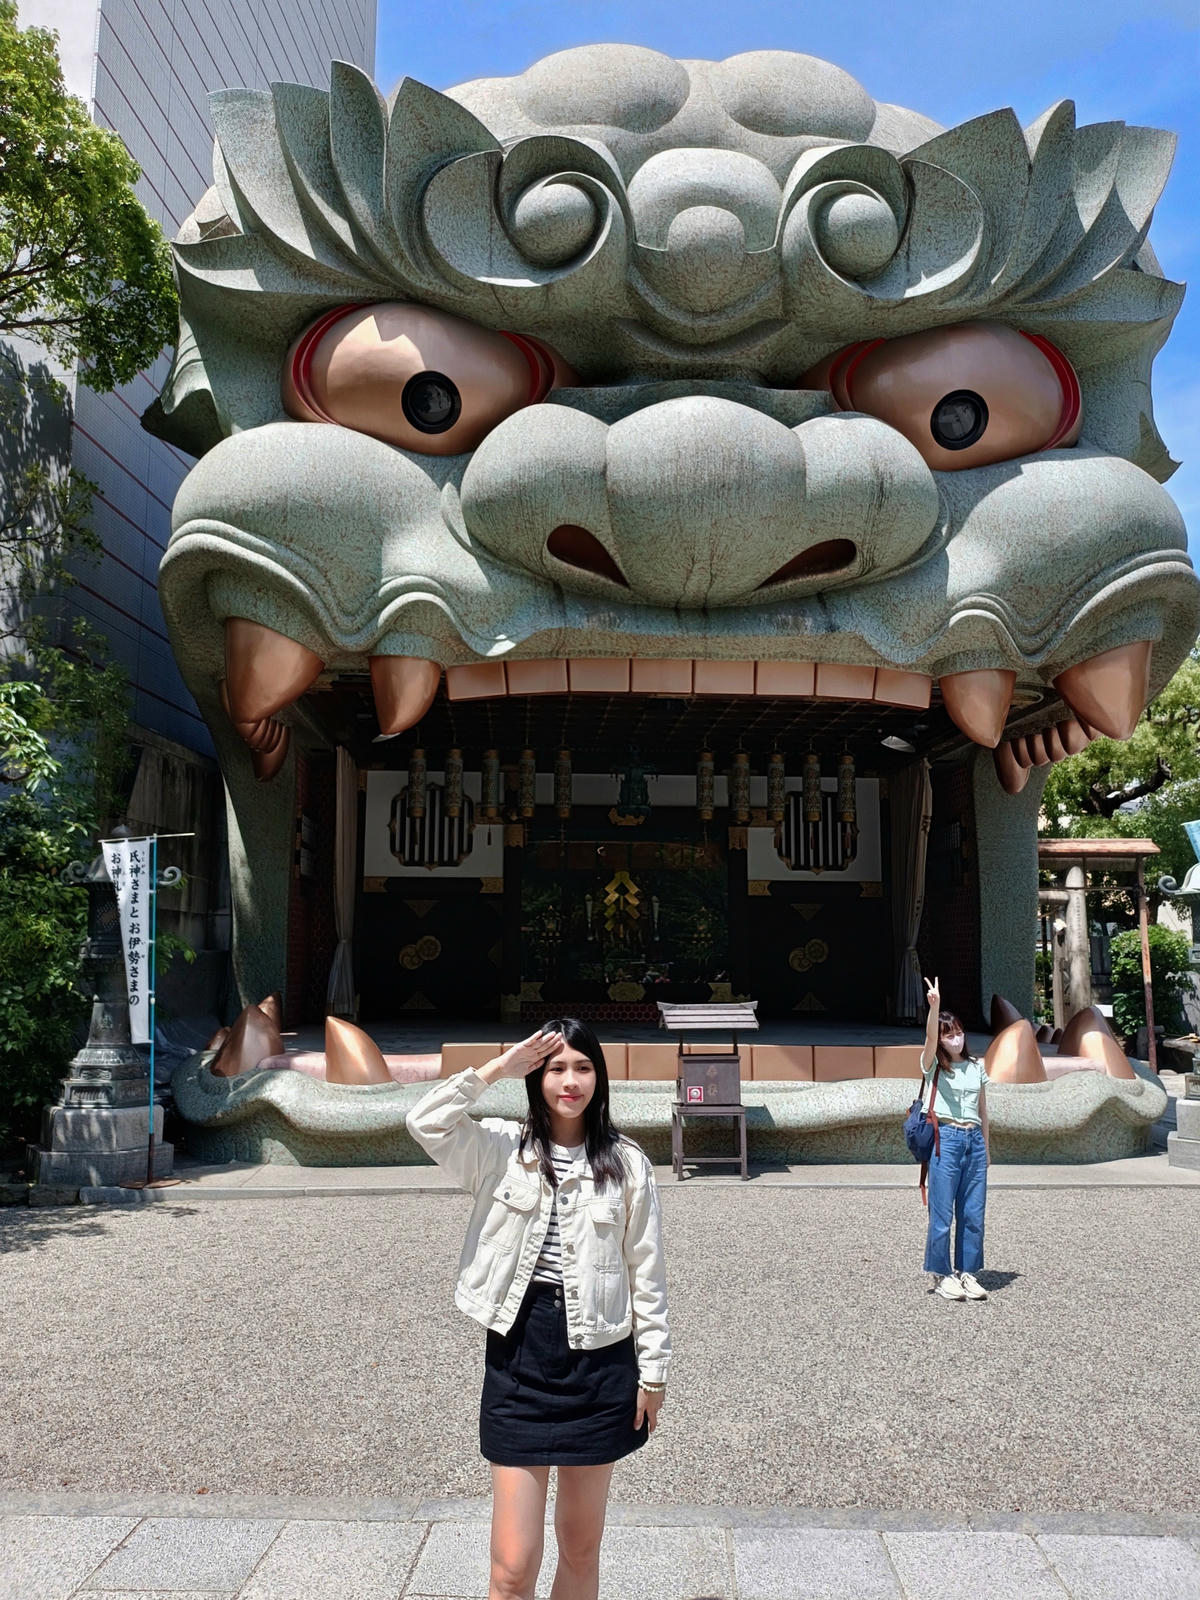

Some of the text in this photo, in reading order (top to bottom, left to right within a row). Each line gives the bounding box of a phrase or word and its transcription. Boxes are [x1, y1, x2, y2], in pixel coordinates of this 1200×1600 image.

[128, 850, 141, 1006] 氏神さまとお伊勢さまの
